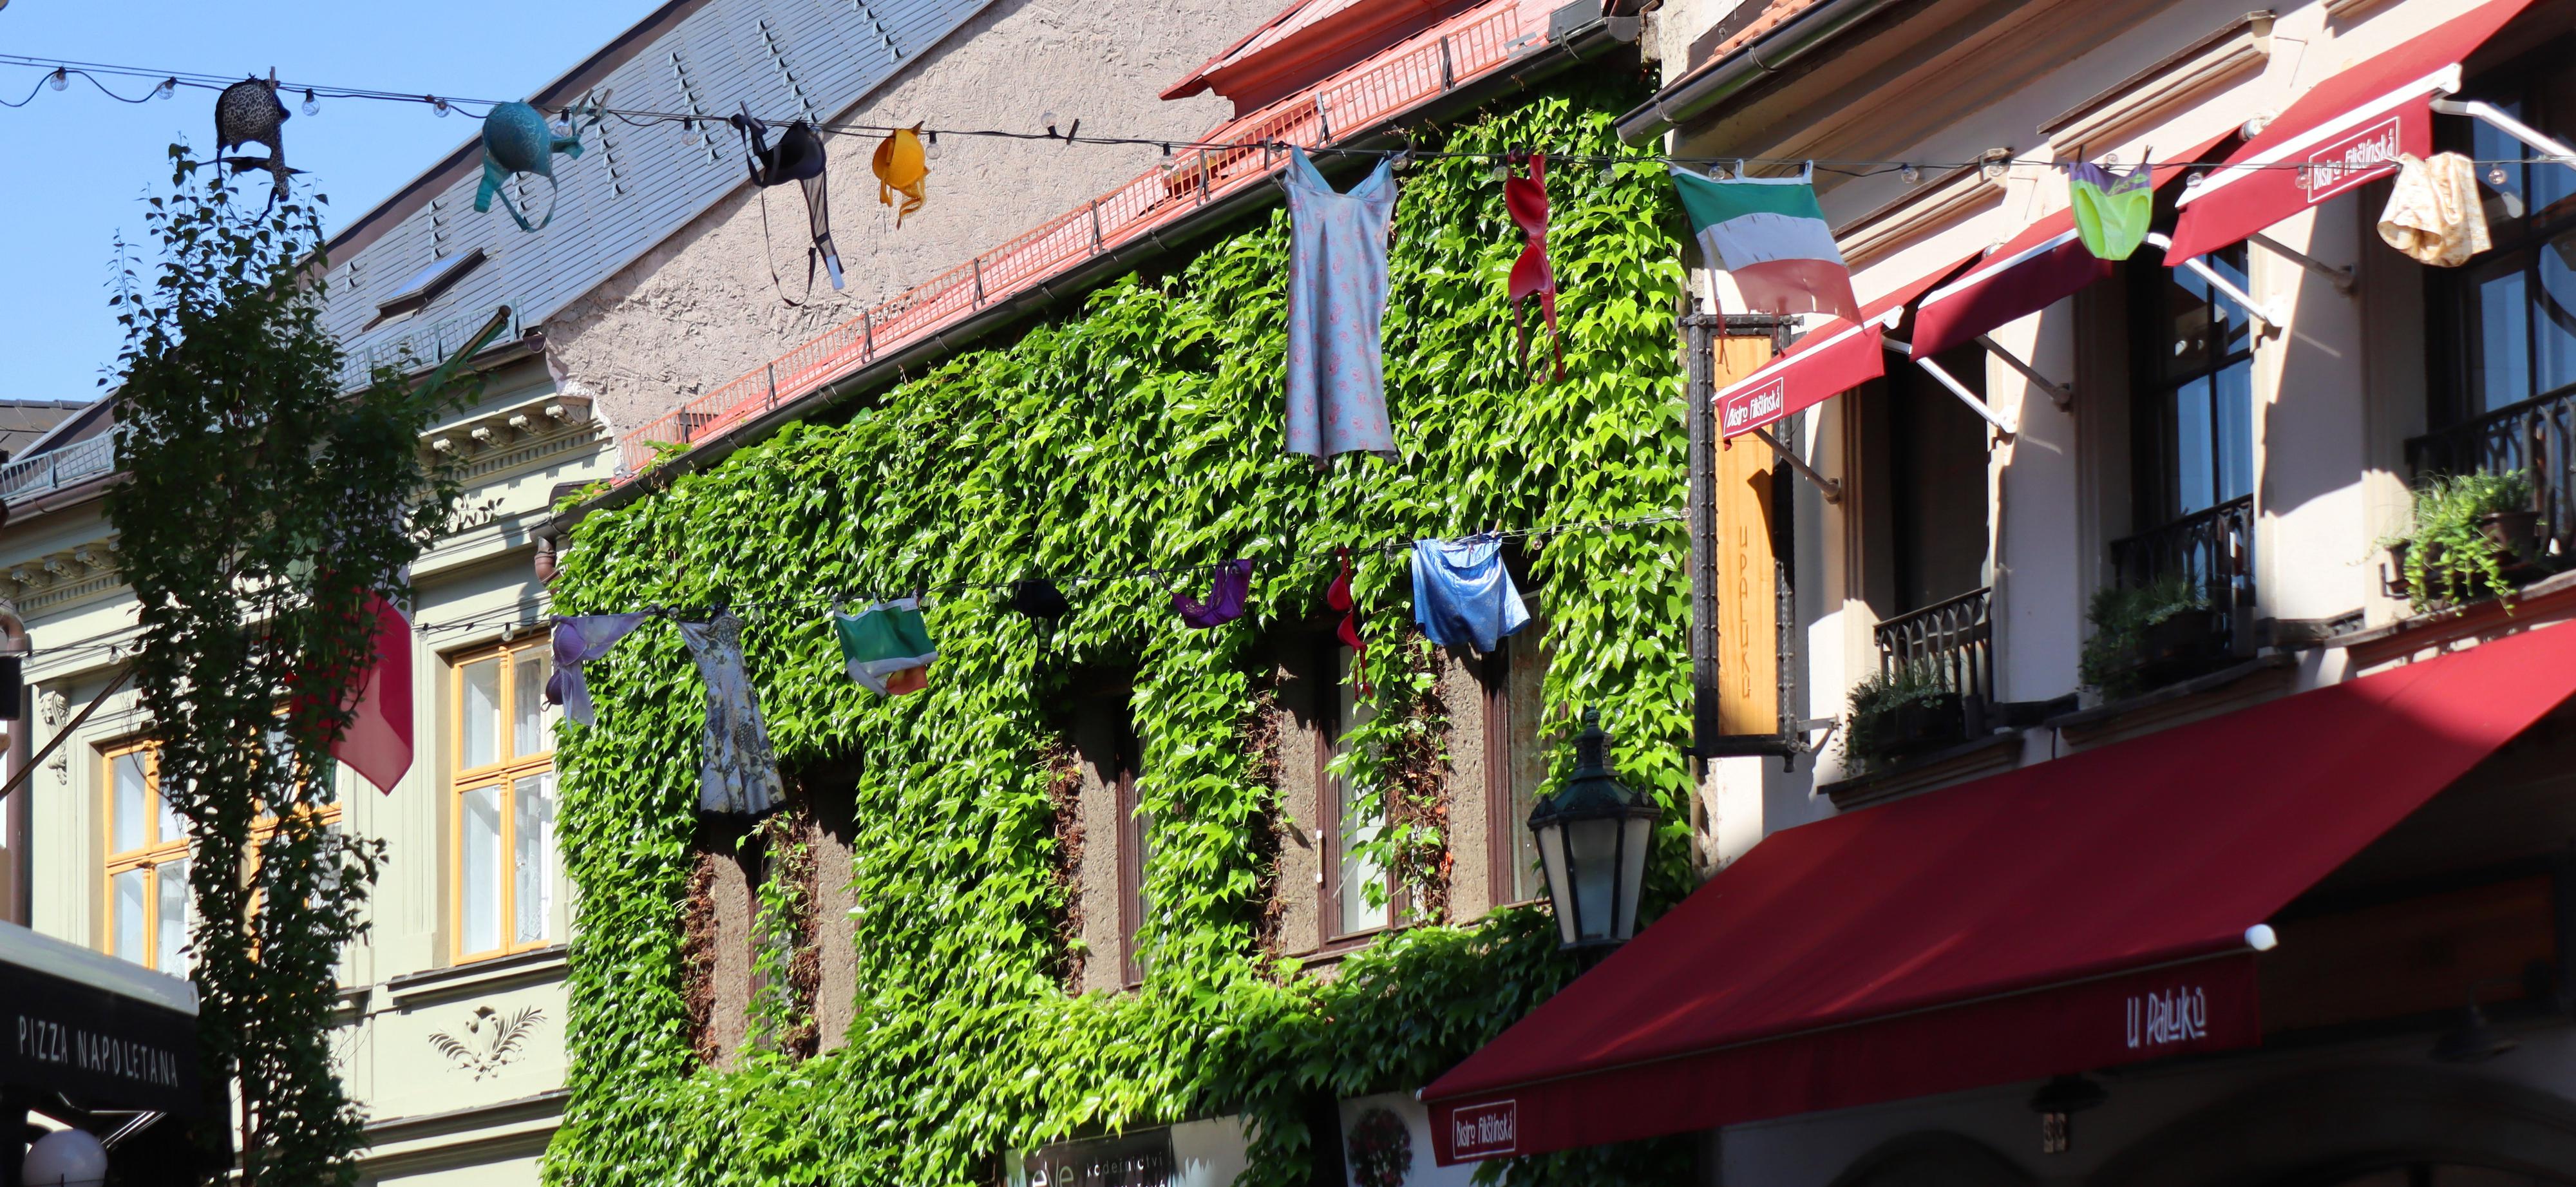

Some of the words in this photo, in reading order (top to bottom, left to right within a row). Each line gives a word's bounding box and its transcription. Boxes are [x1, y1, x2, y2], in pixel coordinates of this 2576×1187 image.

[2313, 159, 2343, 190] Bistro
[1727, 405, 1748, 428] Bistro
[1750, 386, 1780, 420] Filištínská
[2127, 997, 2139, 1049] U
[19, 1016, 68, 1064] PIZZA
[77, 1030, 178, 1088] NAPOLETANA
[1456, 1120, 1476, 1147] Bistro
[1478, 1110, 1513, 1143] Filištínská
